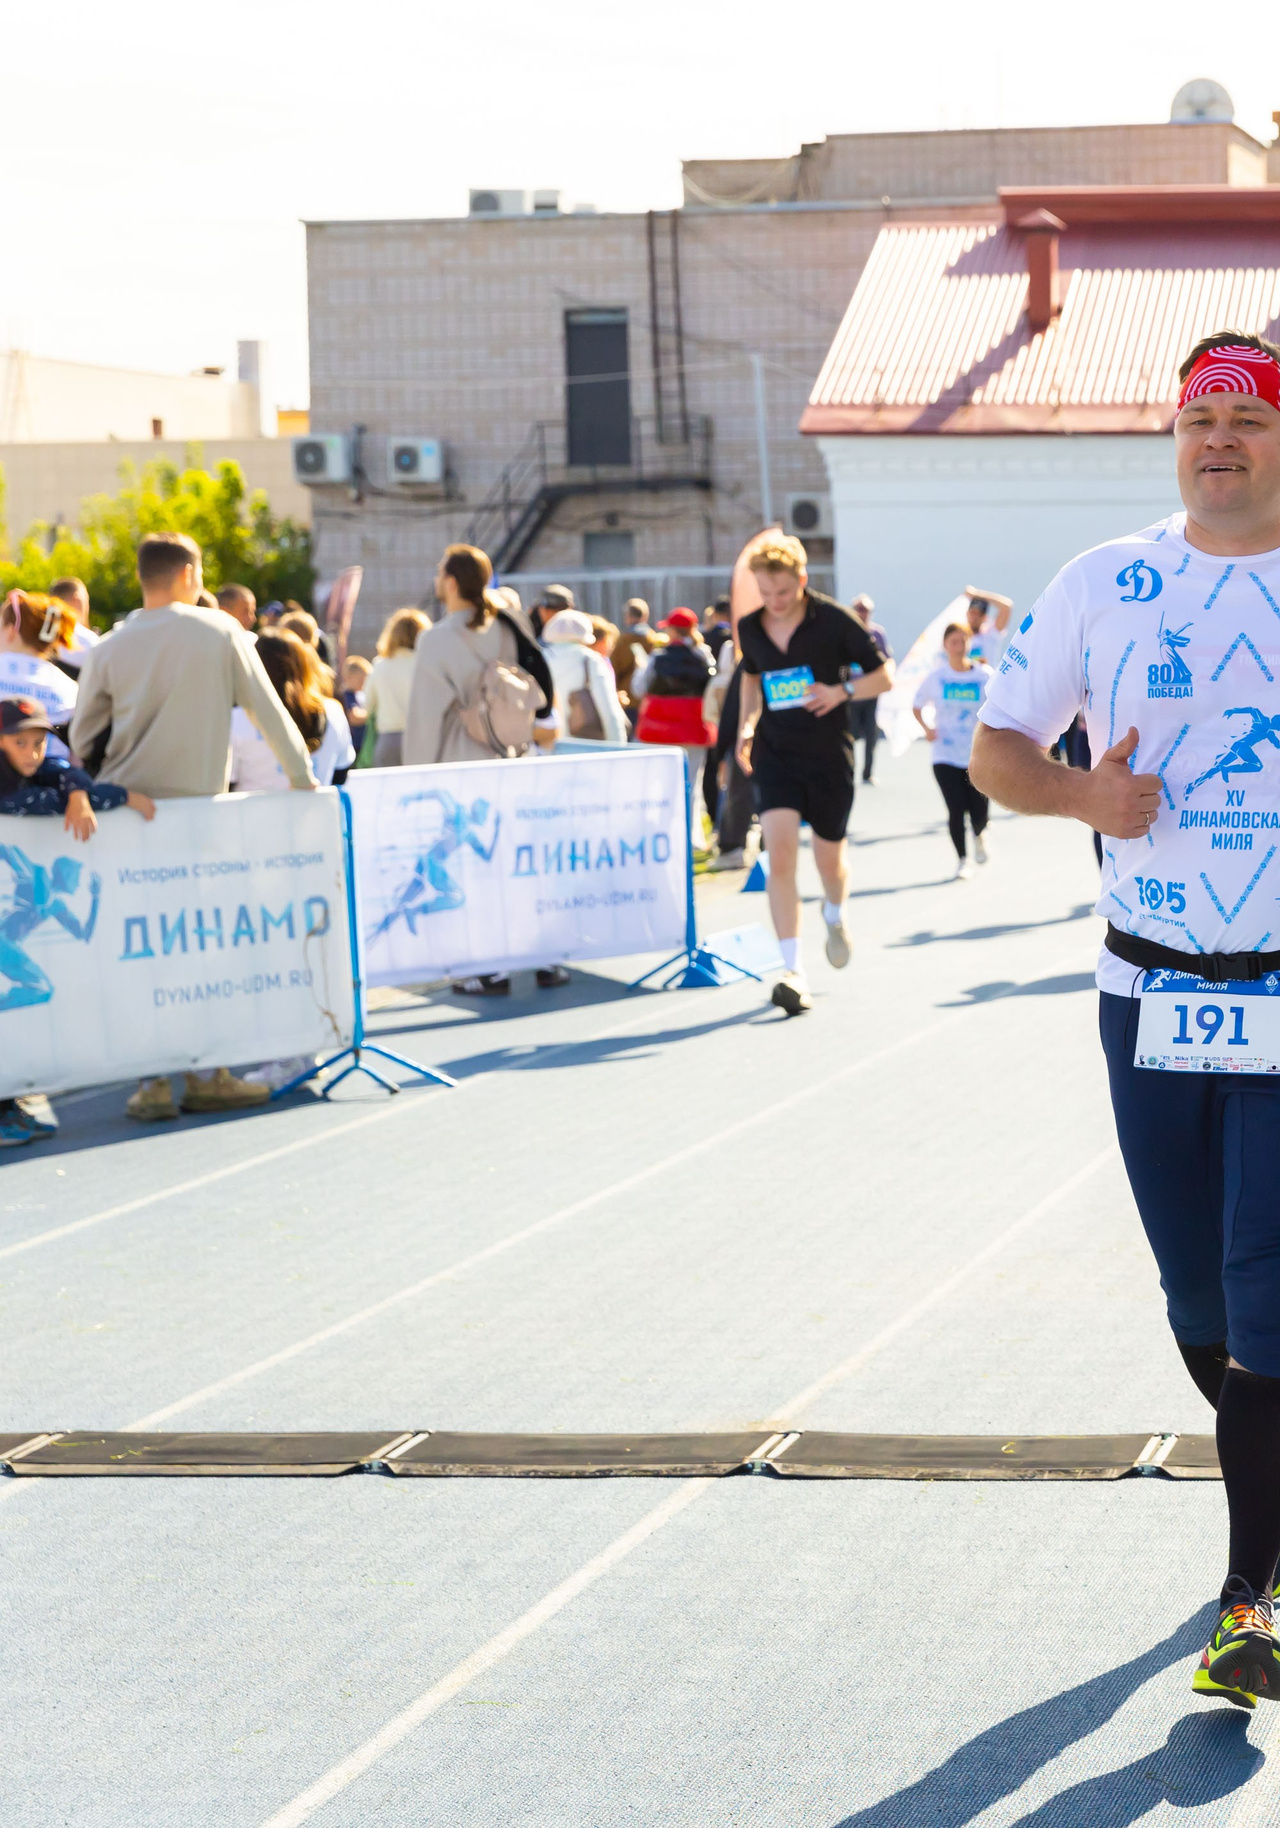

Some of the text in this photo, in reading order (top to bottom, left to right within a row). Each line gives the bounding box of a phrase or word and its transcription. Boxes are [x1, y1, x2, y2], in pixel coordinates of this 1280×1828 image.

[1147, 663, 1173, 685] 80
[1147, 686, 1194, 700] ПОБЕДА!
[1225, 789, 1246, 807] XV
[1211, 833, 1254, 851] МИЛЯ
[511, 832, 672, 878] ДИНАМО
[118, 866, 188, 885] История
[1134, 876, 1187, 914] 105
[118, 895, 332, 962] ДИНАМО
[1196, 981, 1229, 991] МИЛЯ
[1172, 1004, 1249, 1045] 191
